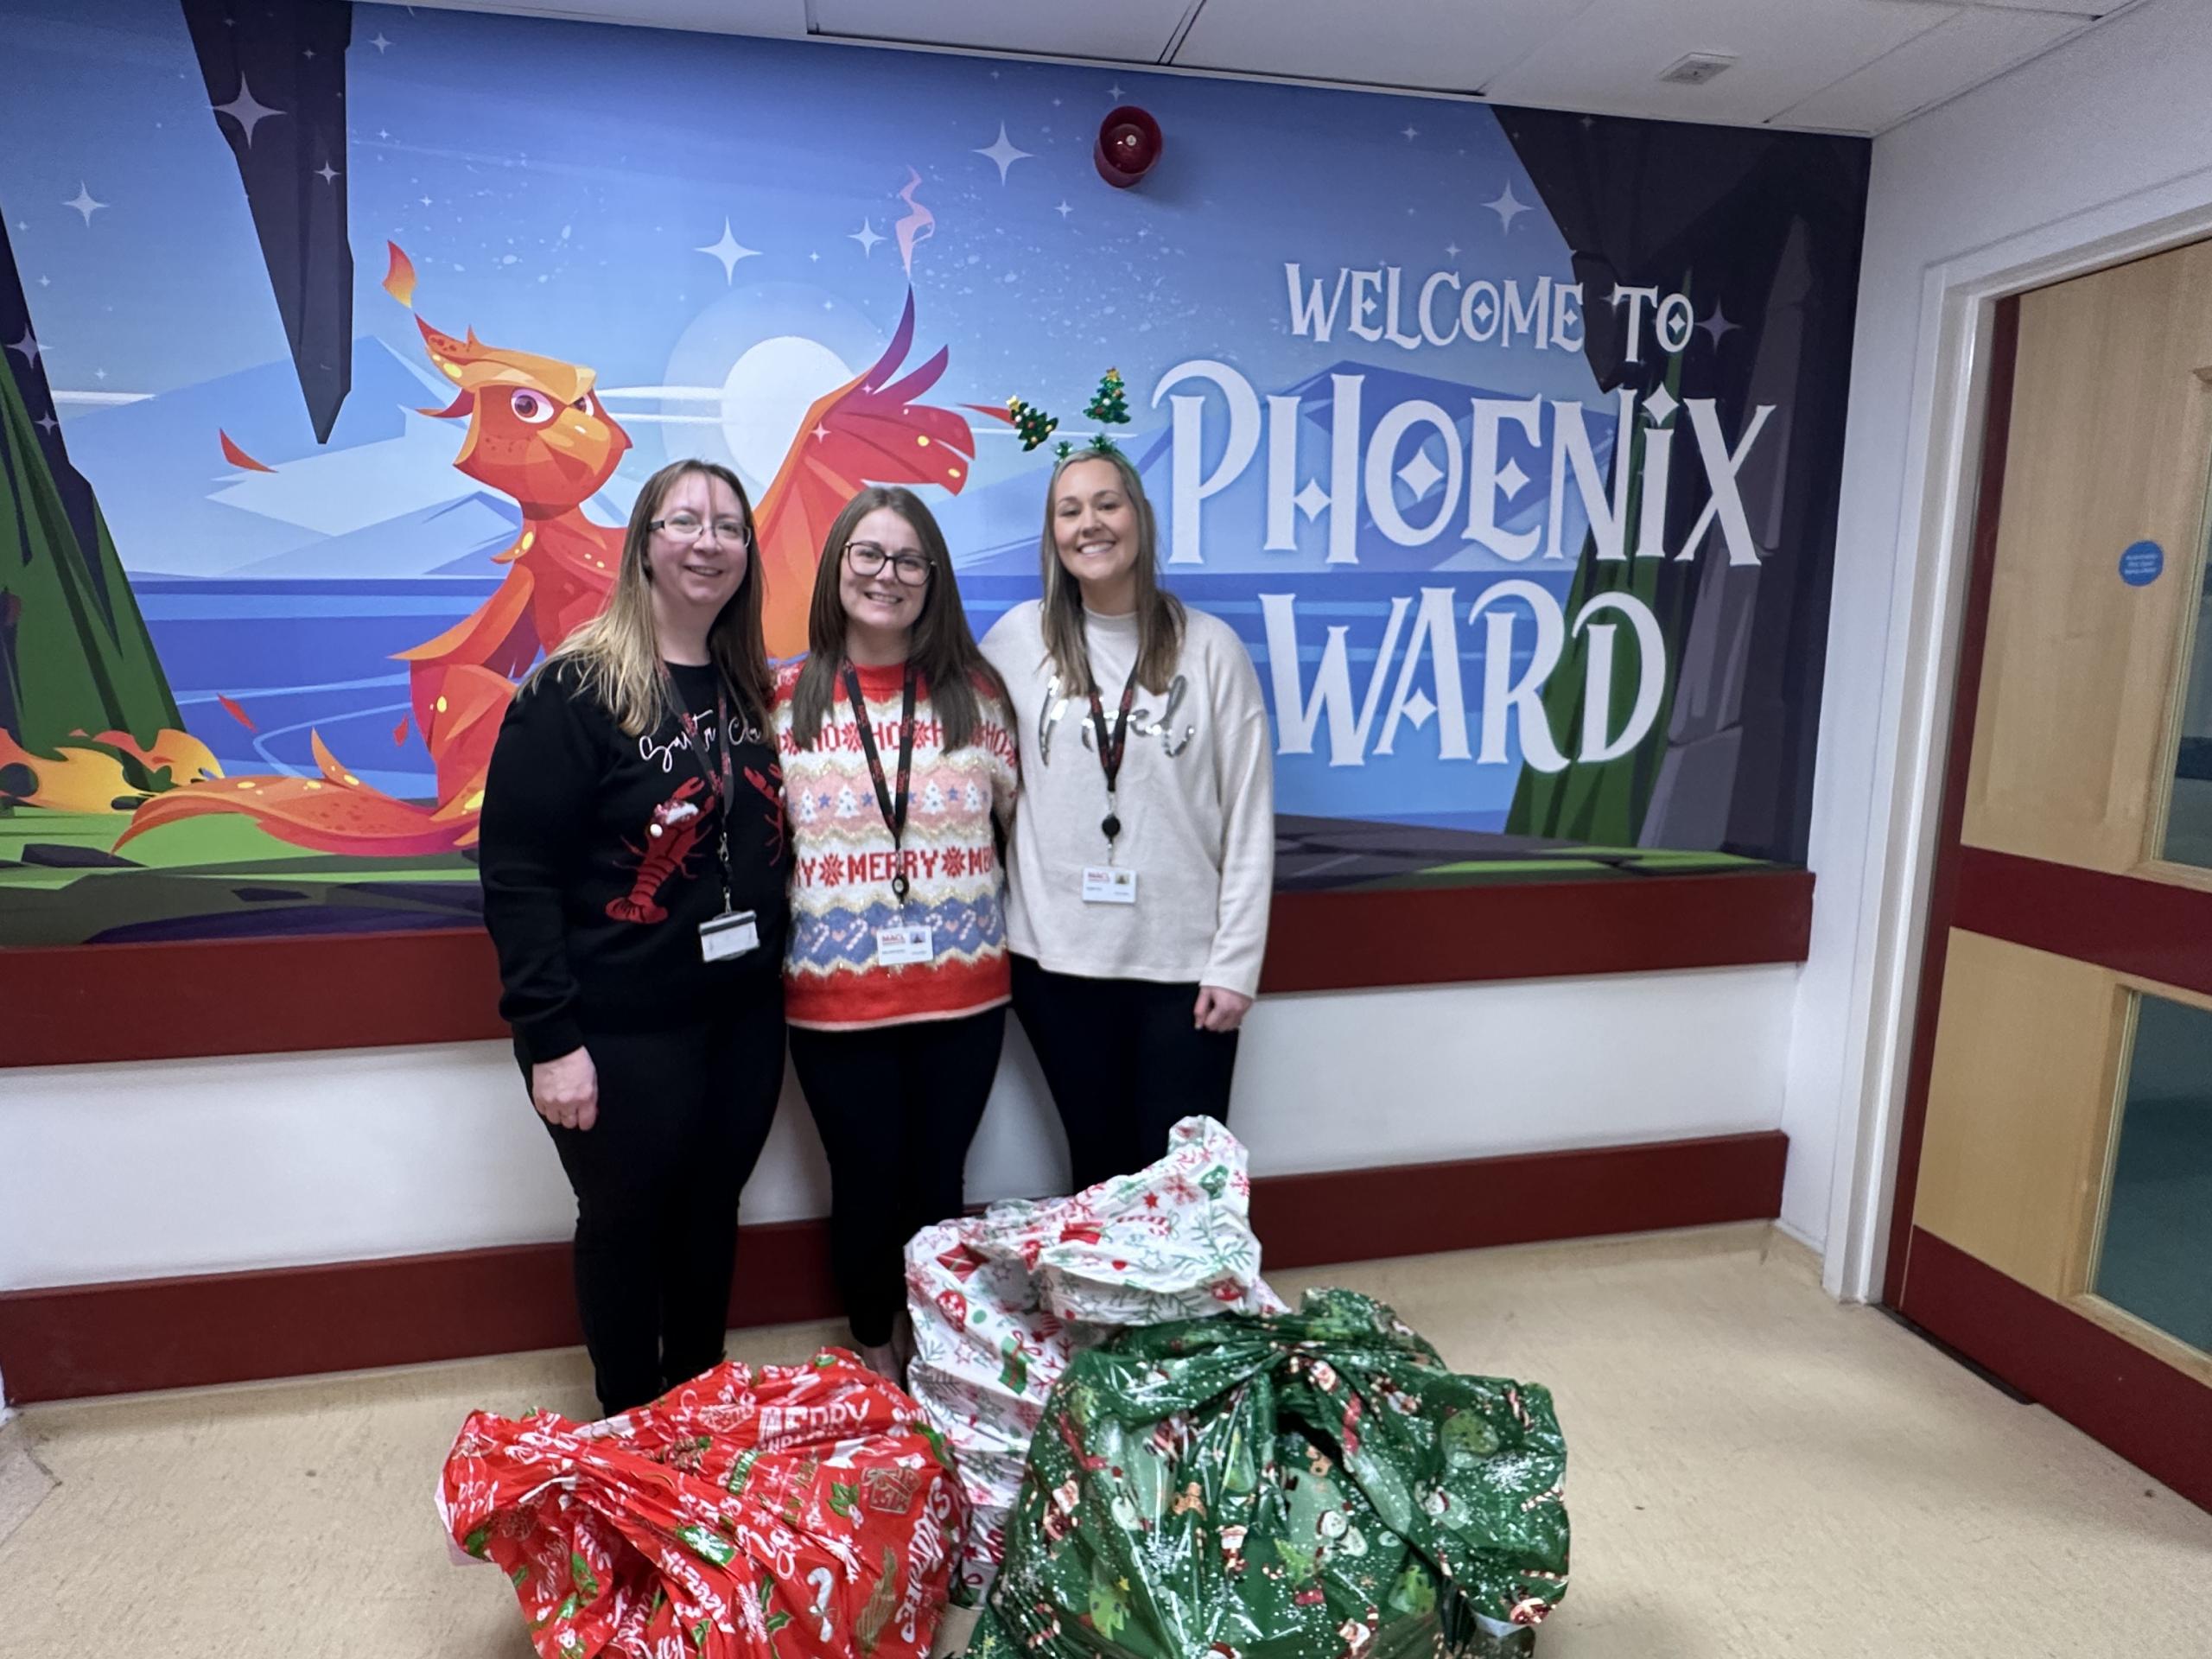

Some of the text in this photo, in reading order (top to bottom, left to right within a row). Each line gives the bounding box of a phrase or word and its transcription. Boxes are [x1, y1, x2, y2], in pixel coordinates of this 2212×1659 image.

[1284, 263, 1694, 363] WELCOME TO
[1151, 359, 1777, 568] PHOENIX
[1258, 579, 1668, 773] WARD
[848, 849, 939, 885] MERRY
